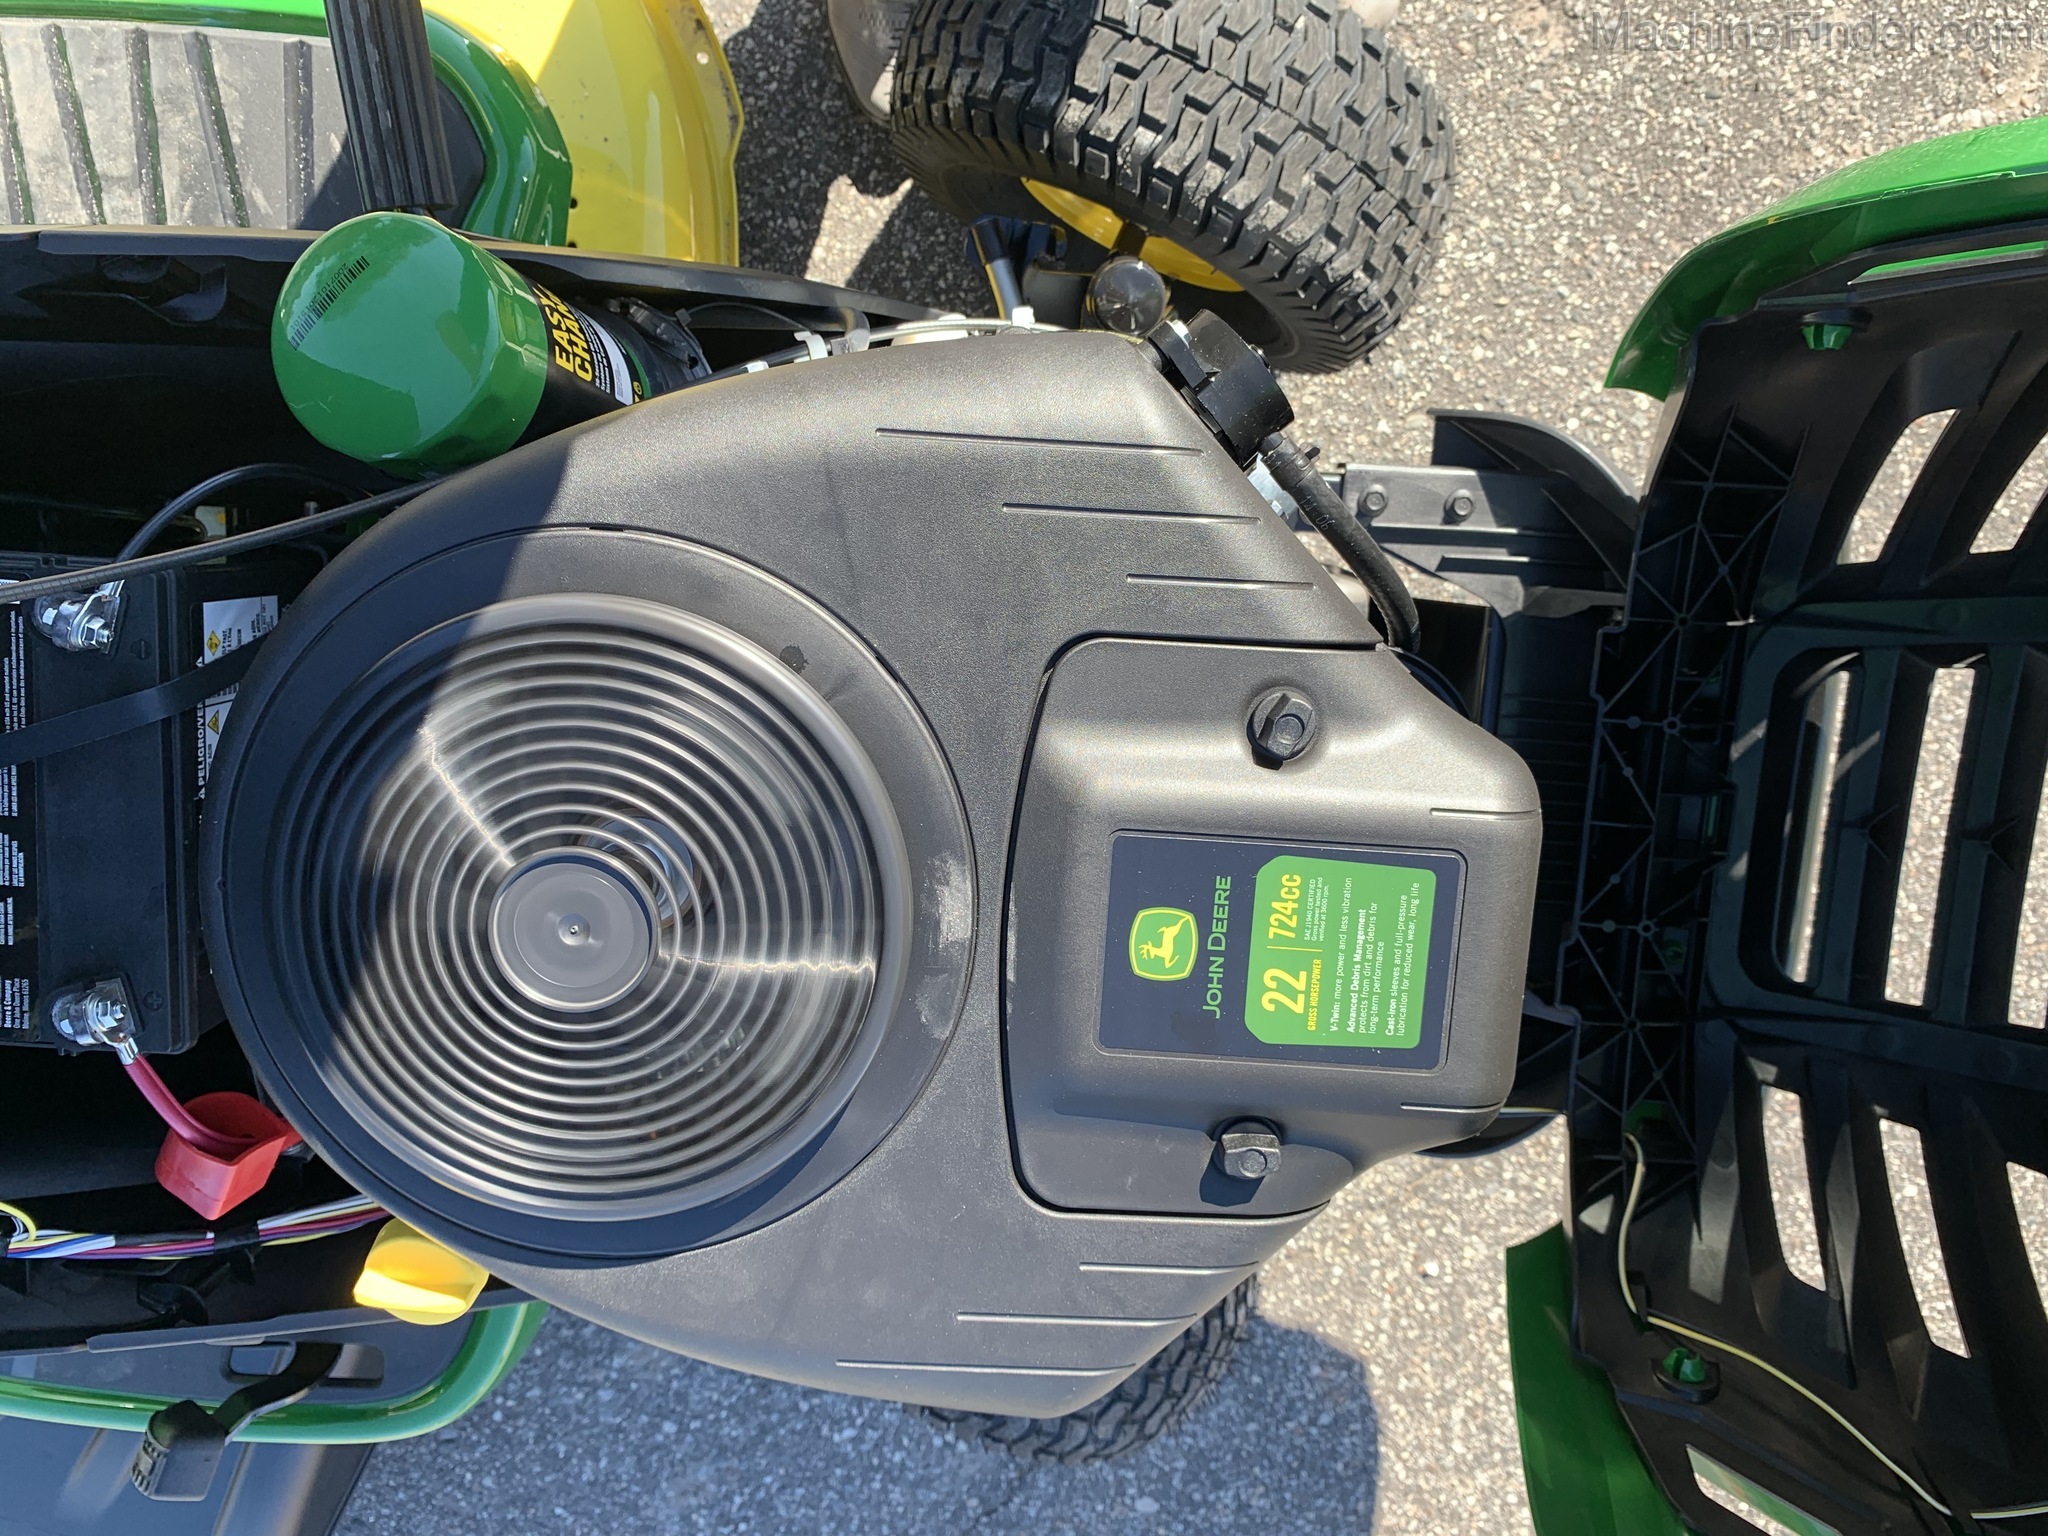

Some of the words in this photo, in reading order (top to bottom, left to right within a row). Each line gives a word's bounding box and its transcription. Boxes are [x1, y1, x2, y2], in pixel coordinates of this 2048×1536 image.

[532, 287, 574, 373] EASY
[1307, 879, 1316, 910] CERTIFIED
[1341, 877, 1352, 913] vibration
[1410, 883, 1420, 896] life
[1207, 875, 1231, 951] DEERE
[1268, 874, 1301, 940] 724cc
[1320, 898, 1328, 913] 3600
[1369, 902, 1378, 913] for
[1408, 899, 1419, 916] long
[1339, 916, 1348, 931] less
[1353, 909, 1366, 961] Management
[1366, 916, 1376, 942] debris
[1394, 895, 1408, 946] full-pressure
[1408, 920, 1416, 941] wear,
[1339, 934, 1347, 950] and
[1366, 944, 1374, 959] and
[1394, 949, 1402, 964] and
[1363, 962, 1371, 976] dirt
[1373, 941, 1384, 992] performance
[1403, 943, 1413, 976] reduced
[1203, 956, 1225, 1019] JOHN
[1261, 968, 1307, 1014] 22
[1310, 959, 1322, 1006] HORSEPOWER
[1334, 978, 1342, 999] more
[1350, 964, 1361, 990] Debris
[1360, 979, 1370, 997] from
[1390, 967, 1400, 996] sleeves
[1401, 978, 1409, 989] for
[4, 980, 12, 1005] Company
[4, 1010, 12, 1028] Deere
[1307, 1006, 1317, 1031] GROSS
[1330, 1002, 1340, 1031] V-Twin:
[1347, 993, 1358, 1033] Advanced
[1359, 1000, 1368, 1033] protects
[1368, 995, 1379, 1034] long-term
[1385, 998, 1397, 1036] Cast-iron
[1396, 992, 1408, 1036] lubrication
